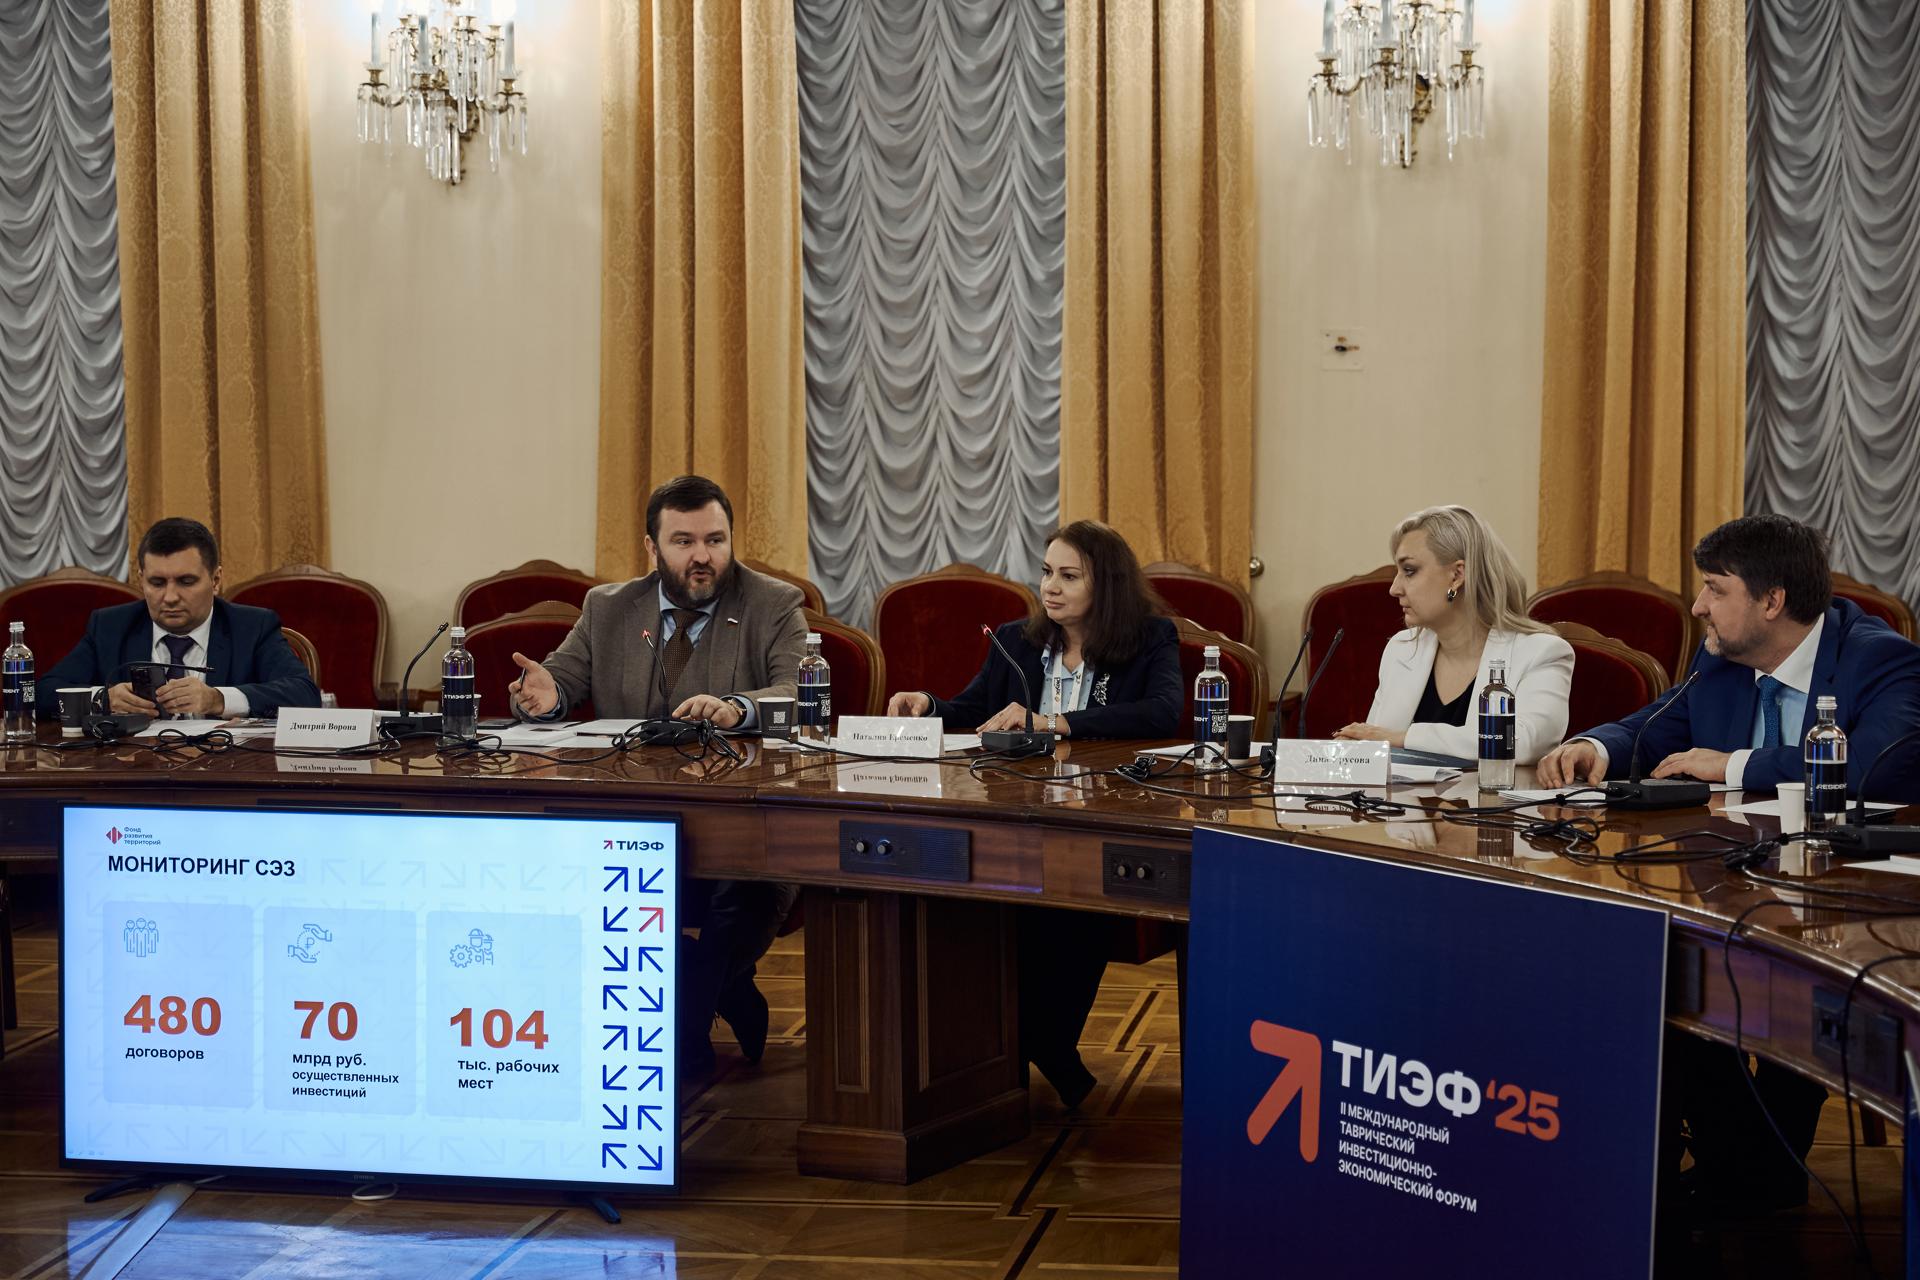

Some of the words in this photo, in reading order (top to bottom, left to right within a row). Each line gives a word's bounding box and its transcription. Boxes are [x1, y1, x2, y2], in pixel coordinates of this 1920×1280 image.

[290, 722, 326, 731] Дмитрий
[328, 722, 357, 731] Ворона
[616, 840, 665, 851] ТИЭФ
[108, 855, 250, 876] МОНИТОРИНГ
[255, 859, 296, 877] СЭЗ
[123, 994, 222, 1036] 480
[293, 1000, 359, 1041] 70
[449, 1007, 549, 1050] 104
[125, 1046, 205, 1060] договоров
[292, 1053, 332, 1067] млрд
[336, 1053, 367, 1067] руб.
[457, 1059, 492, 1071] тыс.
[495, 1060, 560, 1074] рабочих
[292, 1070, 399, 1084] осуществленных
[458, 1078, 494, 1090] мест
[292, 1085, 367, 1099] инвестиций
[1340, 1101, 1348, 1117] II
[1348, 1104, 1450, 1145] МЕЖДУНАРОДНЫЙ
[1340, 1120, 1415, 1154] ТАВРИЧЕСКИЙ
[1339, 1140, 1438, 1180] ИНВЕСТИЦИОННО-
[1338, 1159, 1433, 1200] ЭКОНОМИЧЕСКИЙ
[1435, 1188, 1477, 1213] ФОРУМ
